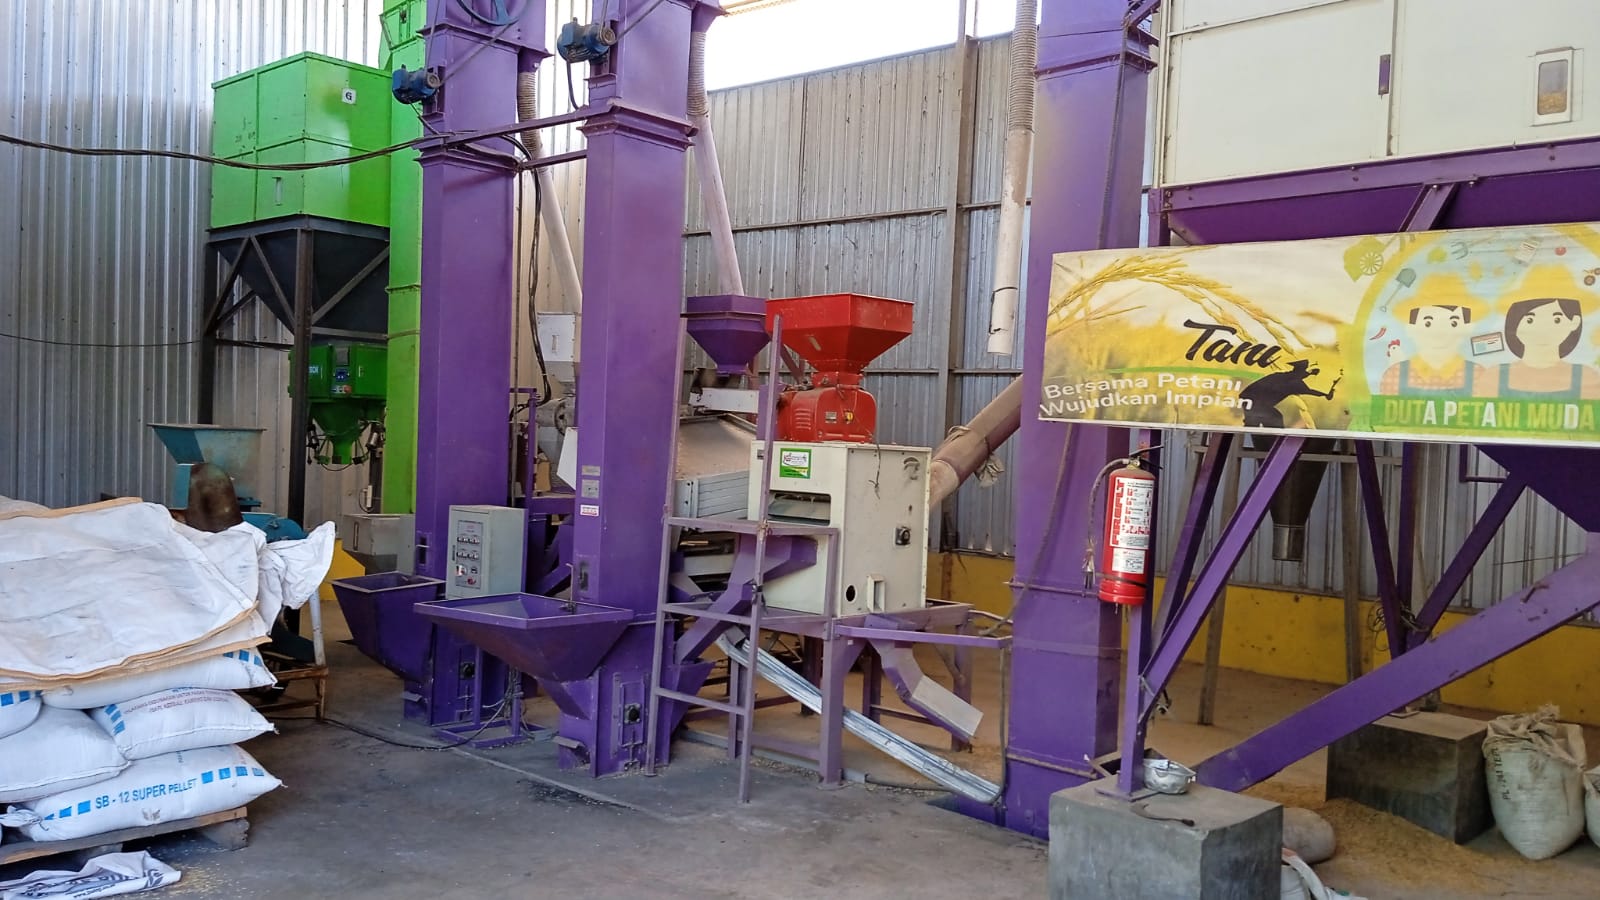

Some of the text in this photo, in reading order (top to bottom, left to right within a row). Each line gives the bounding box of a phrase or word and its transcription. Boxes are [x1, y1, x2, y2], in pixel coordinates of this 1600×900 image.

[345, 91, 352, 101] G
[1044, 372, 1242, 400] Bersama Petani
[1039, 389, 1253, 417] Wujudkan Impian
[1384, 399, 1595, 431] DUTA PETANI MUDA
[95, 795, 110, 809] SB
[118, 791, 130, 804] 12
[132, 783, 166, 802] SUPER
[168, 777, 198, 794] PELLET
